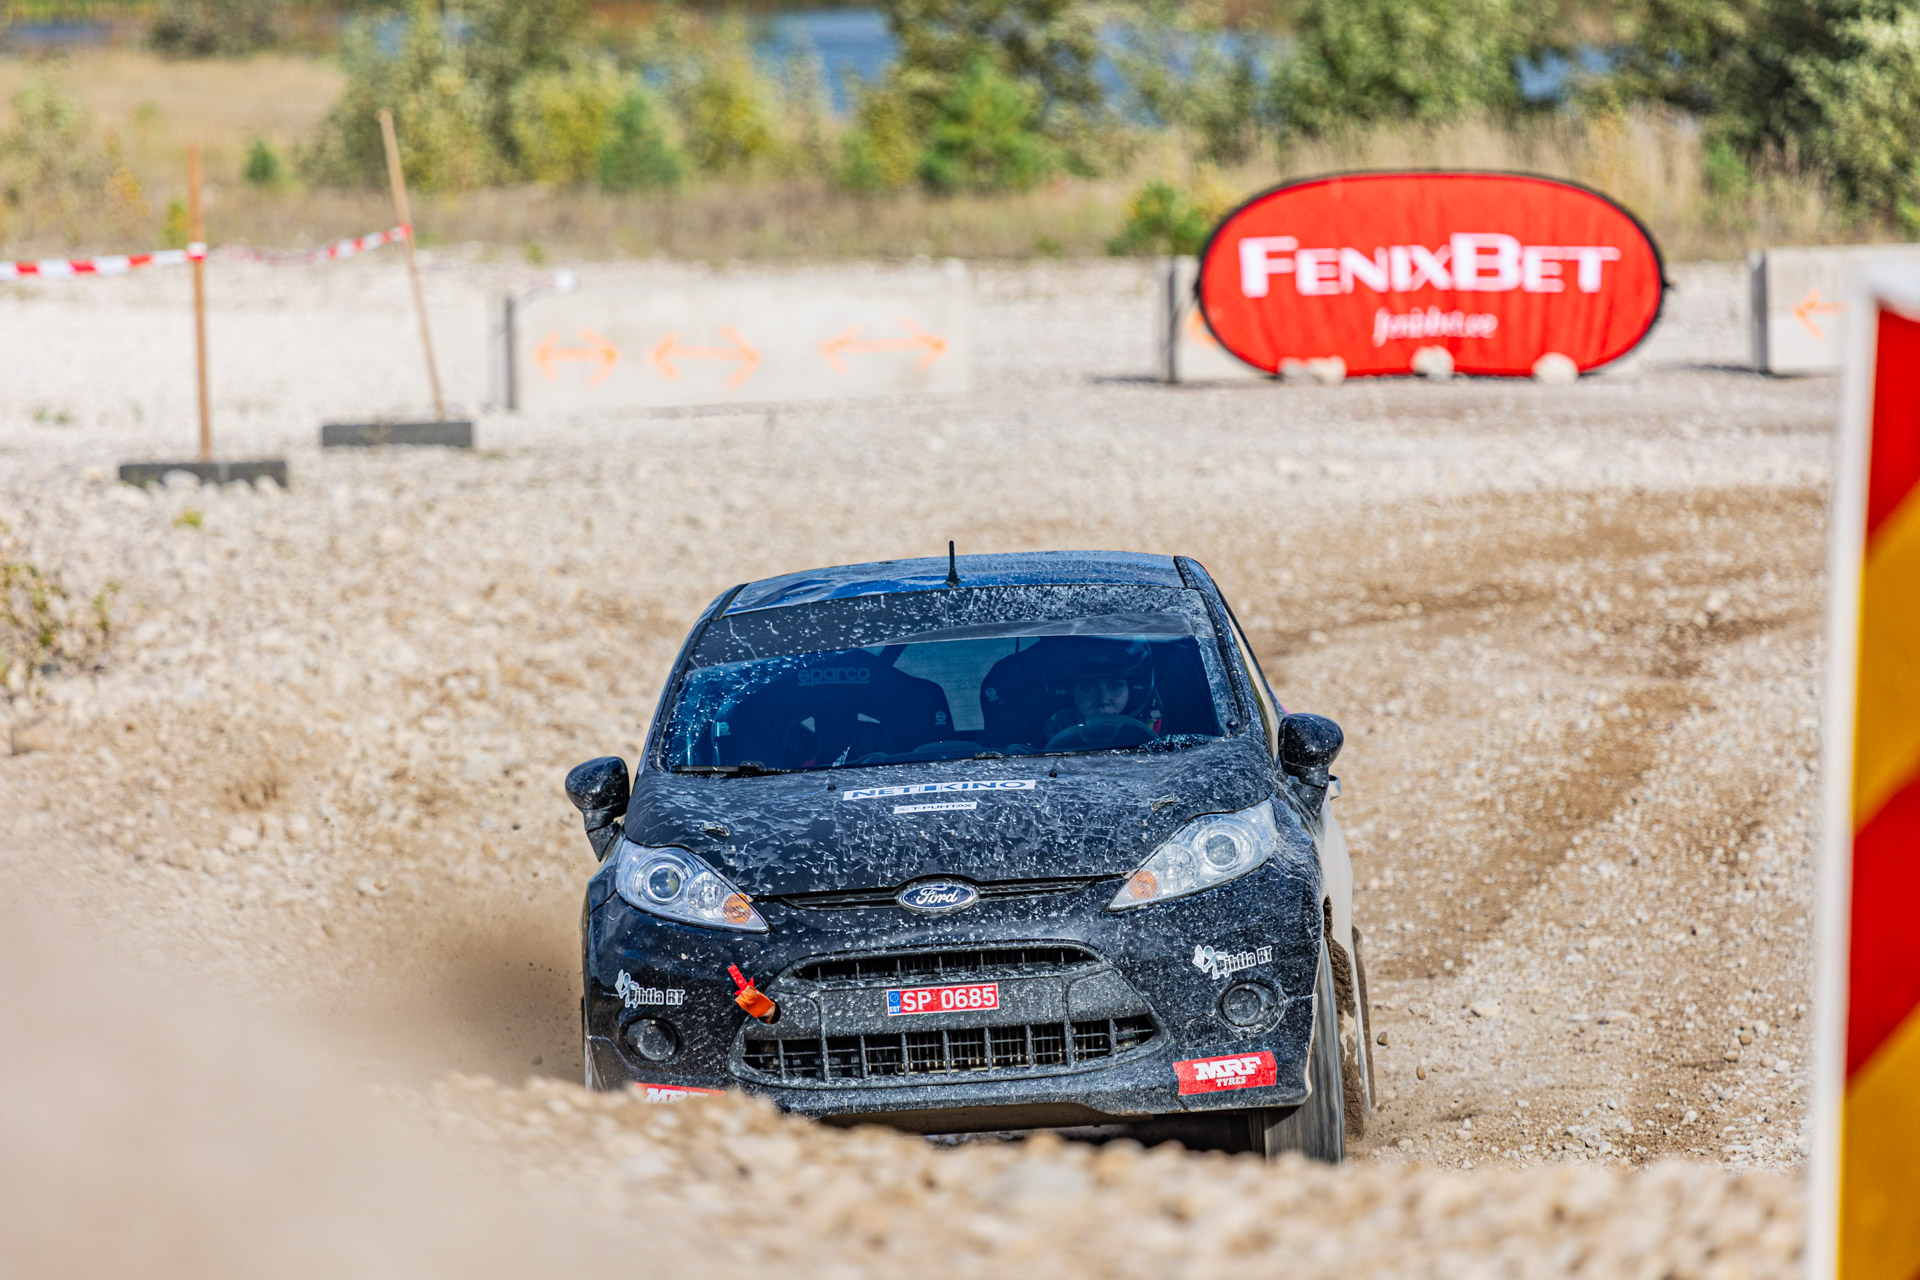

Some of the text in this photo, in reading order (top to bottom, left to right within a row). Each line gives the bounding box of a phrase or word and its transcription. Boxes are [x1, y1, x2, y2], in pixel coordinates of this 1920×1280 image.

[798, 667, 870, 686] sparco
[916, 887, 958, 904] Ford
[1257, 945, 1272, 964] RT
[666, 989, 685, 1005] RT
[902, 987, 995, 1011] SP 0685
[1193, 1056, 1262, 1081] MRF
[1216, 1076, 1246, 1087] TYRES
